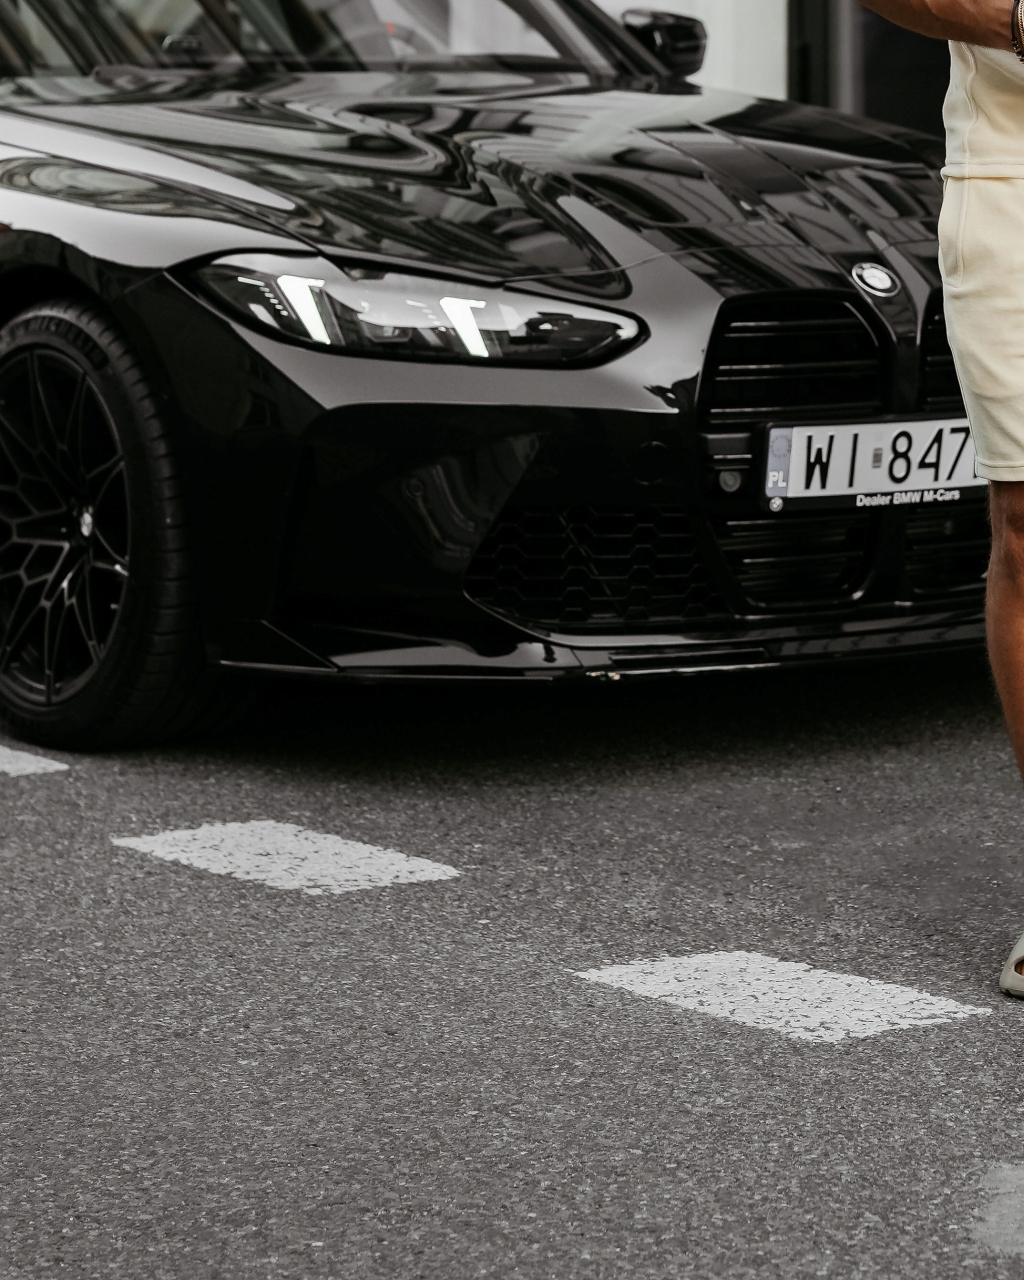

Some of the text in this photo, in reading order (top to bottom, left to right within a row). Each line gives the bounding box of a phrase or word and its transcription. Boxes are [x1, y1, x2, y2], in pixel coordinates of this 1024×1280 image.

[888, 426, 977, 484] 847
[767, 471, 787, 488] PL
[856, 489, 961, 507] Dealer BMW M-Cars
